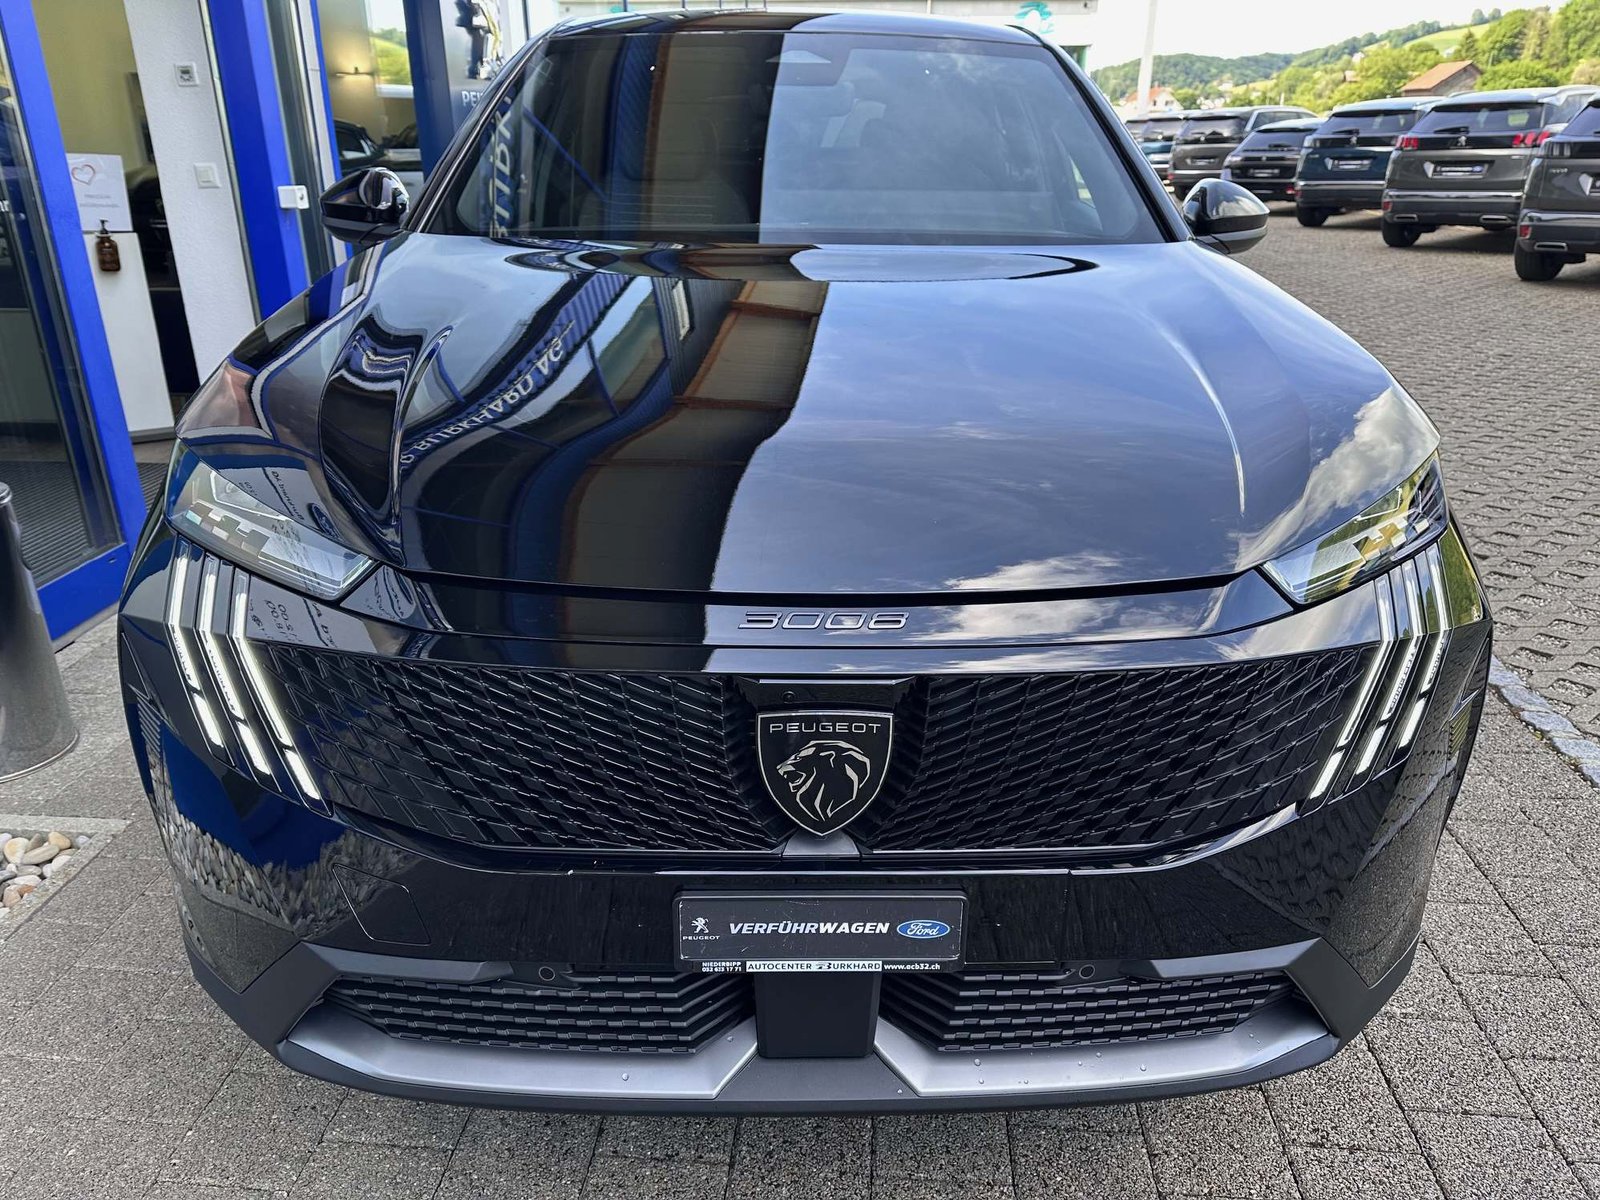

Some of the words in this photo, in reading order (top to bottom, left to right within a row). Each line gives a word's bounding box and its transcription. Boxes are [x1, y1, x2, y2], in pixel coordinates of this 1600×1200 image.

[738, 611, 909, 630] 3008
[769, 722, 881, 734] PEUGEOT
[729, 921, 890, 934] VERFÜHRWAGEN
[907, 922, 940, 936] Ford
[748, 962, 812, 970] AUTOCENTER
[826, 962, 881, 970] BURKHARD
